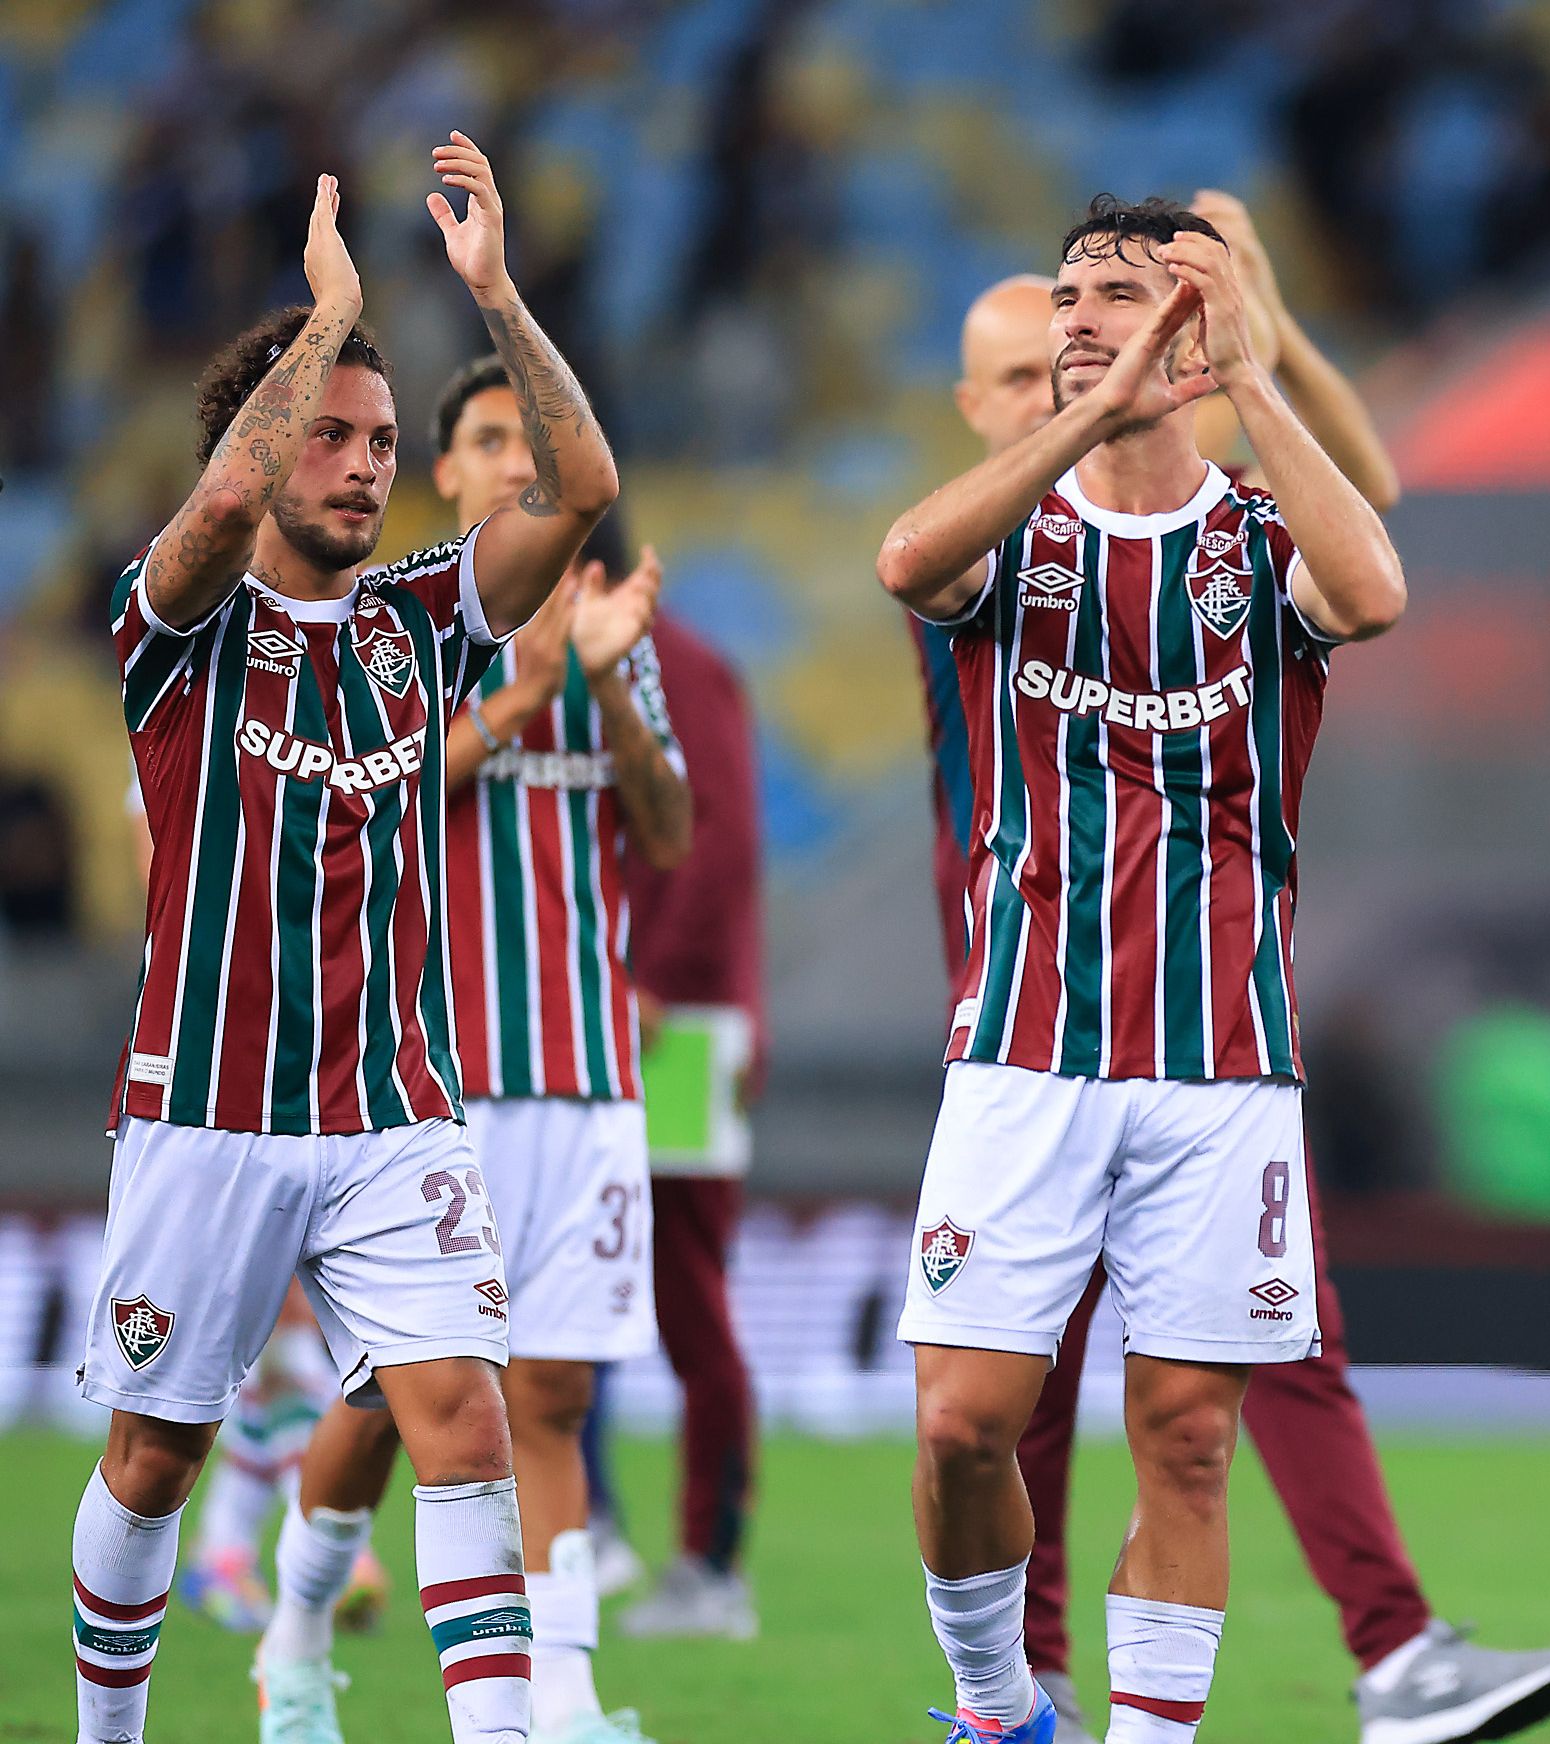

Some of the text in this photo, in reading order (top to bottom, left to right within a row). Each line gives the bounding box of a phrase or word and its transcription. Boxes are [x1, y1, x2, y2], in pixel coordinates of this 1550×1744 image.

[1021, 594, 1076, 611] umbro
[246, 656, 296, 678] umbro
[1017, 660, 1250, 731] SUPERBET
[1257, 1161, 1290, 1258] 8
[1250, 1307, 1293, 1321] umbro
